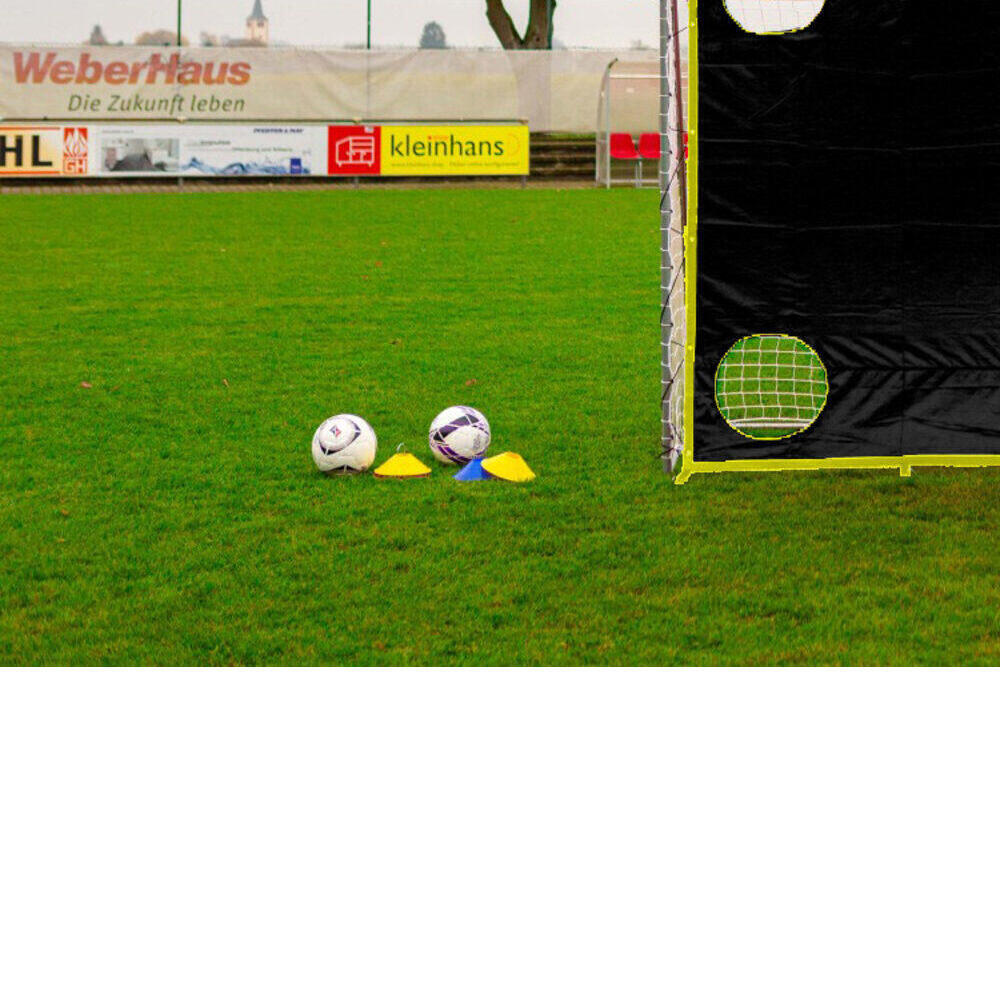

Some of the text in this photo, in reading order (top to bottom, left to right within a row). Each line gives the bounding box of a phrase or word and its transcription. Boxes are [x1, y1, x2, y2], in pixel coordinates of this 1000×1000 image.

[12, 51, 252, 86] WeberHaus
[67, 94, 246, 116] Die Zukunft leben
[389, 133, 505, 157] kleinhans
